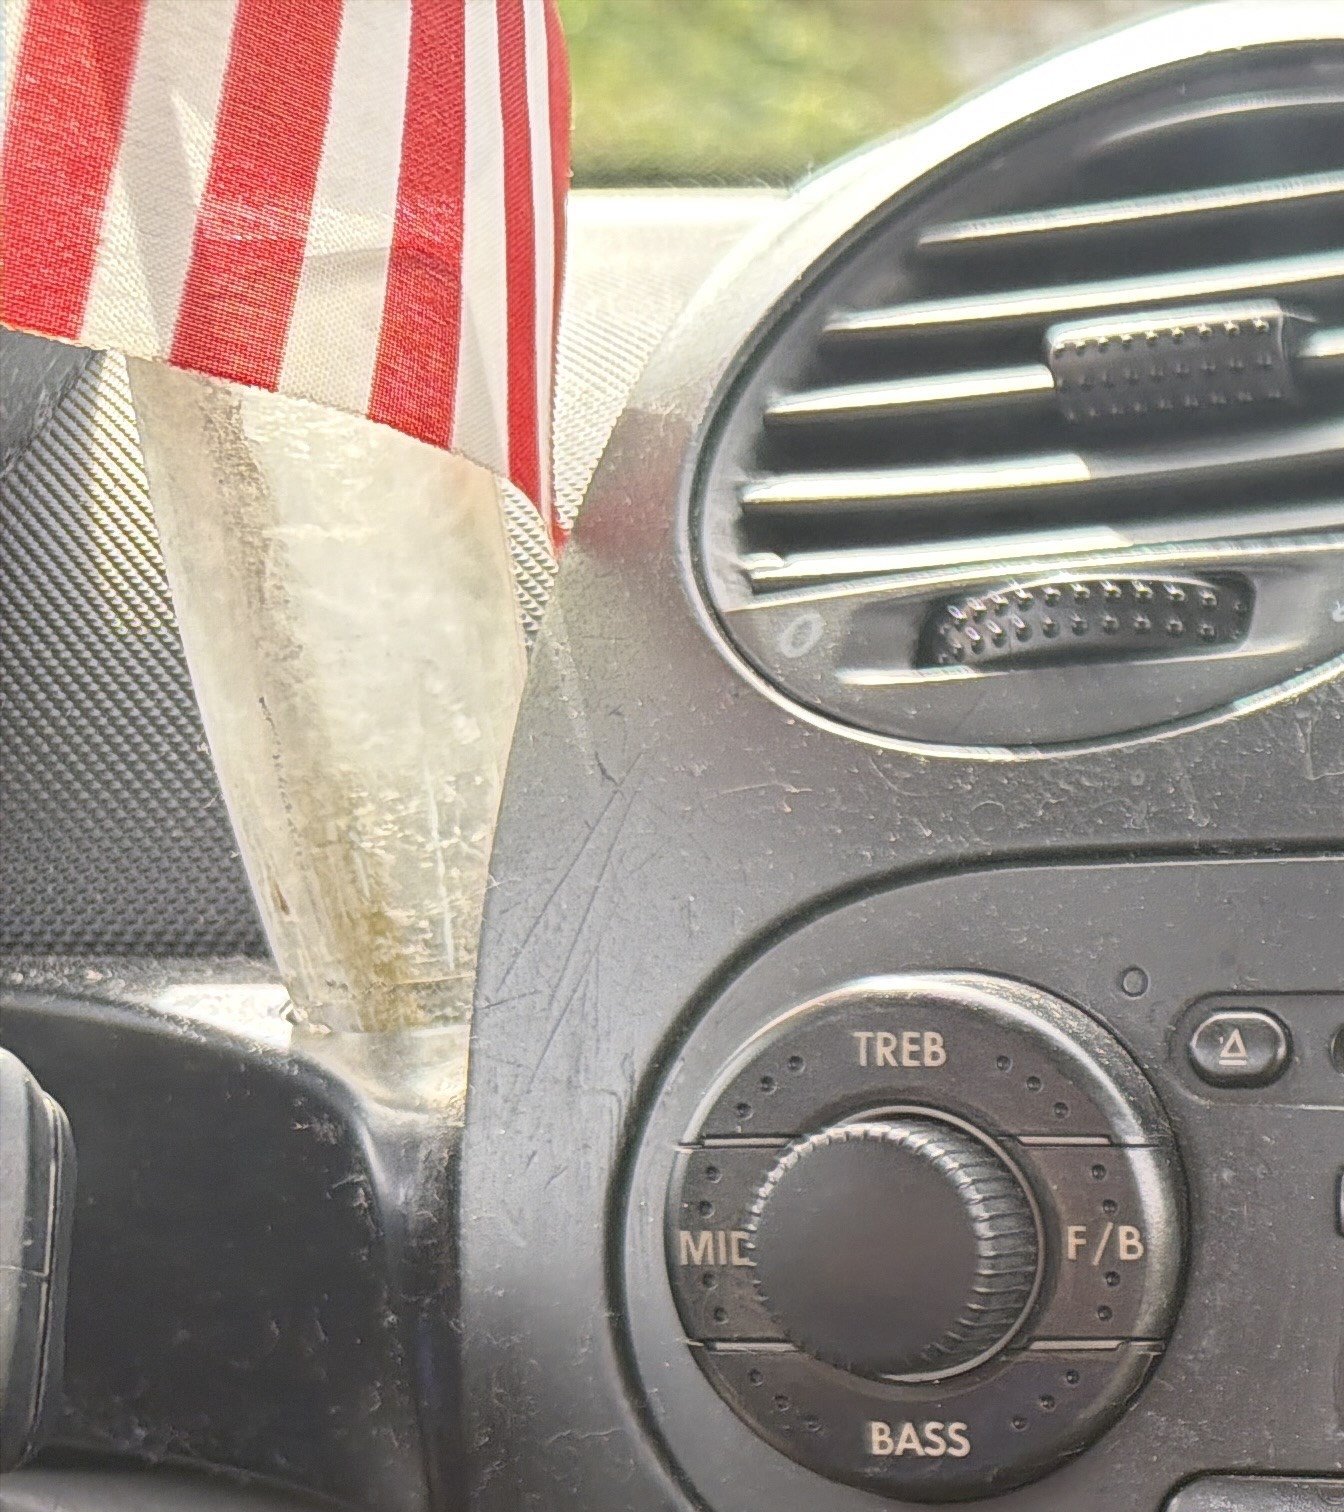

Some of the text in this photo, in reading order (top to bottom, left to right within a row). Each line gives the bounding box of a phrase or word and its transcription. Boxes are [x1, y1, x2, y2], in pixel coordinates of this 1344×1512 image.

[853, 1031, 947, 1068] TREB
[1066, 1224, 1145, 1265] F/B
[870, 1422, 971, 1457] BASS
